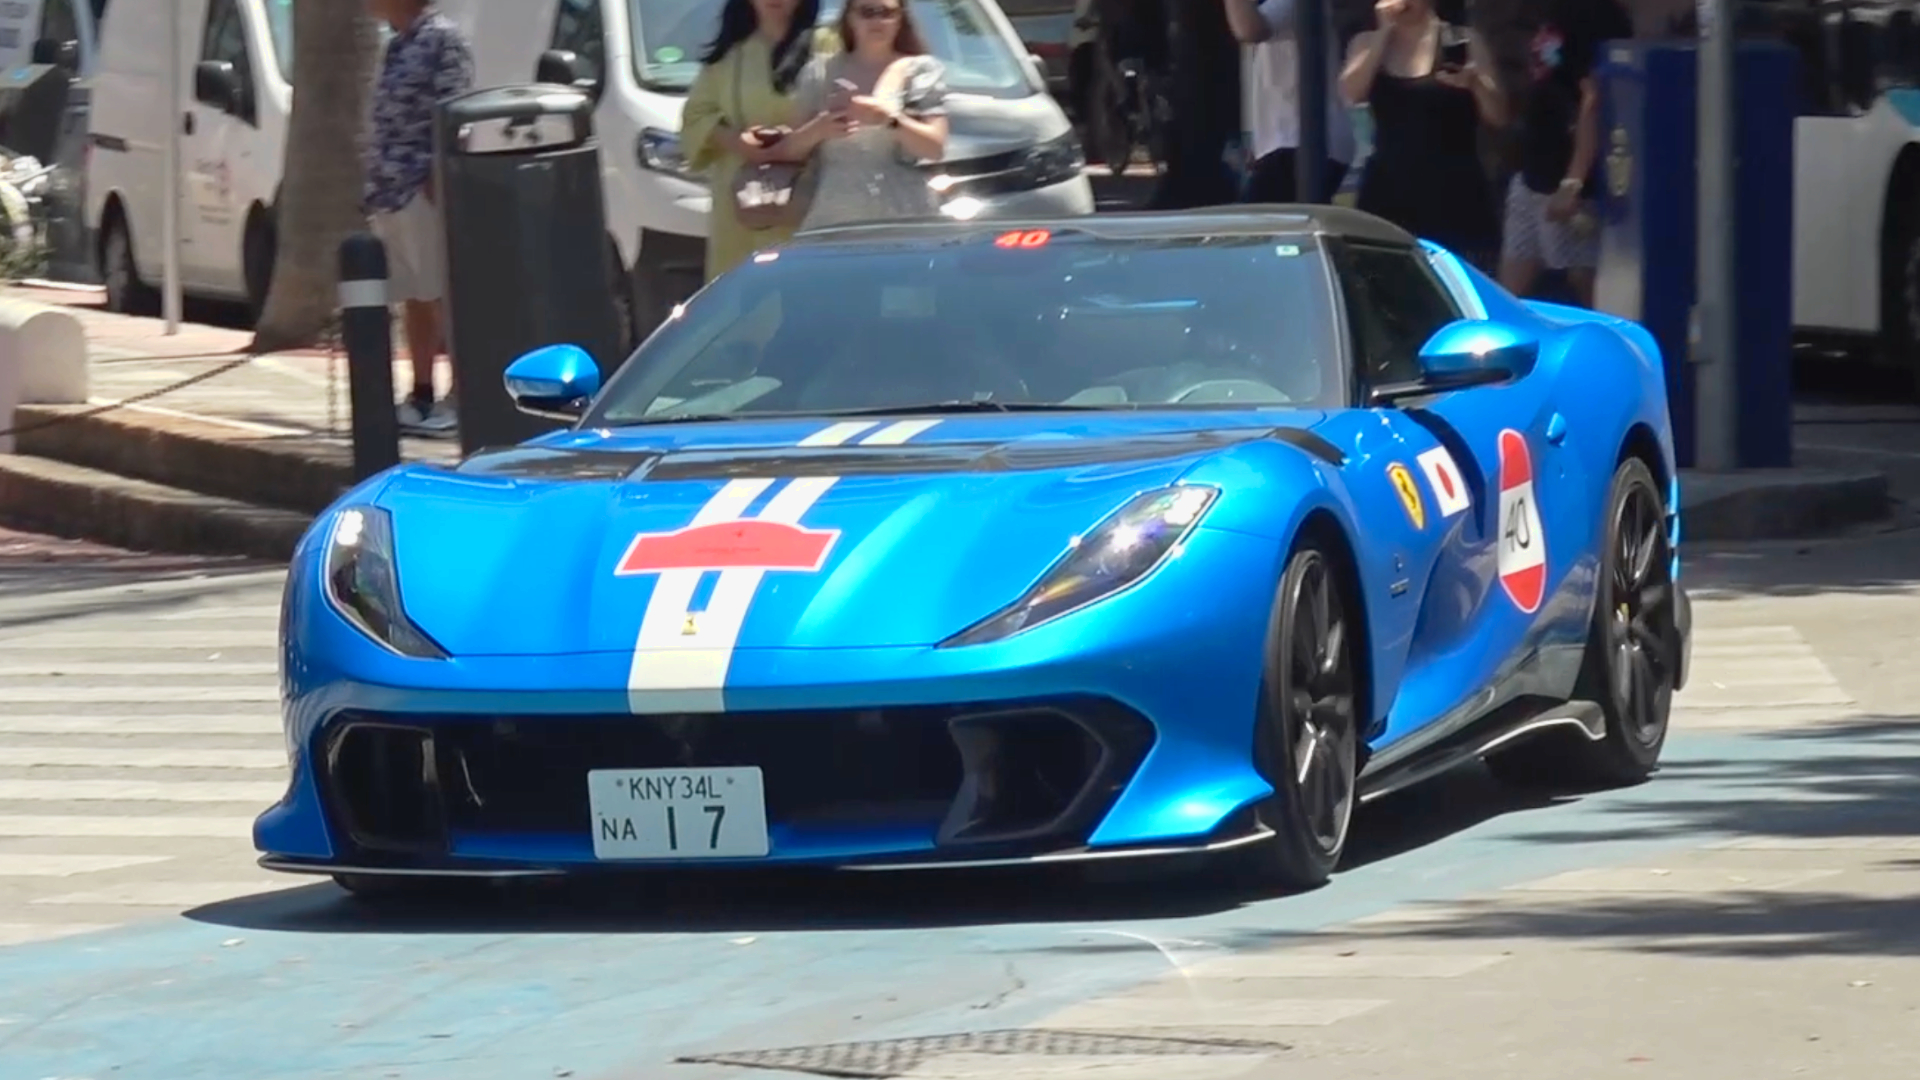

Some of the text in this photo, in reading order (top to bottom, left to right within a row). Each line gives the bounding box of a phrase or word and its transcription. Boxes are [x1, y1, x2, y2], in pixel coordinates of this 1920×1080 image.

[994, 229, 1050, 249] 40
[1505, 497, 1530, 552] 40
[629, 775, 722, 801] KNY34L
[601, 818, 637, 841] NA
